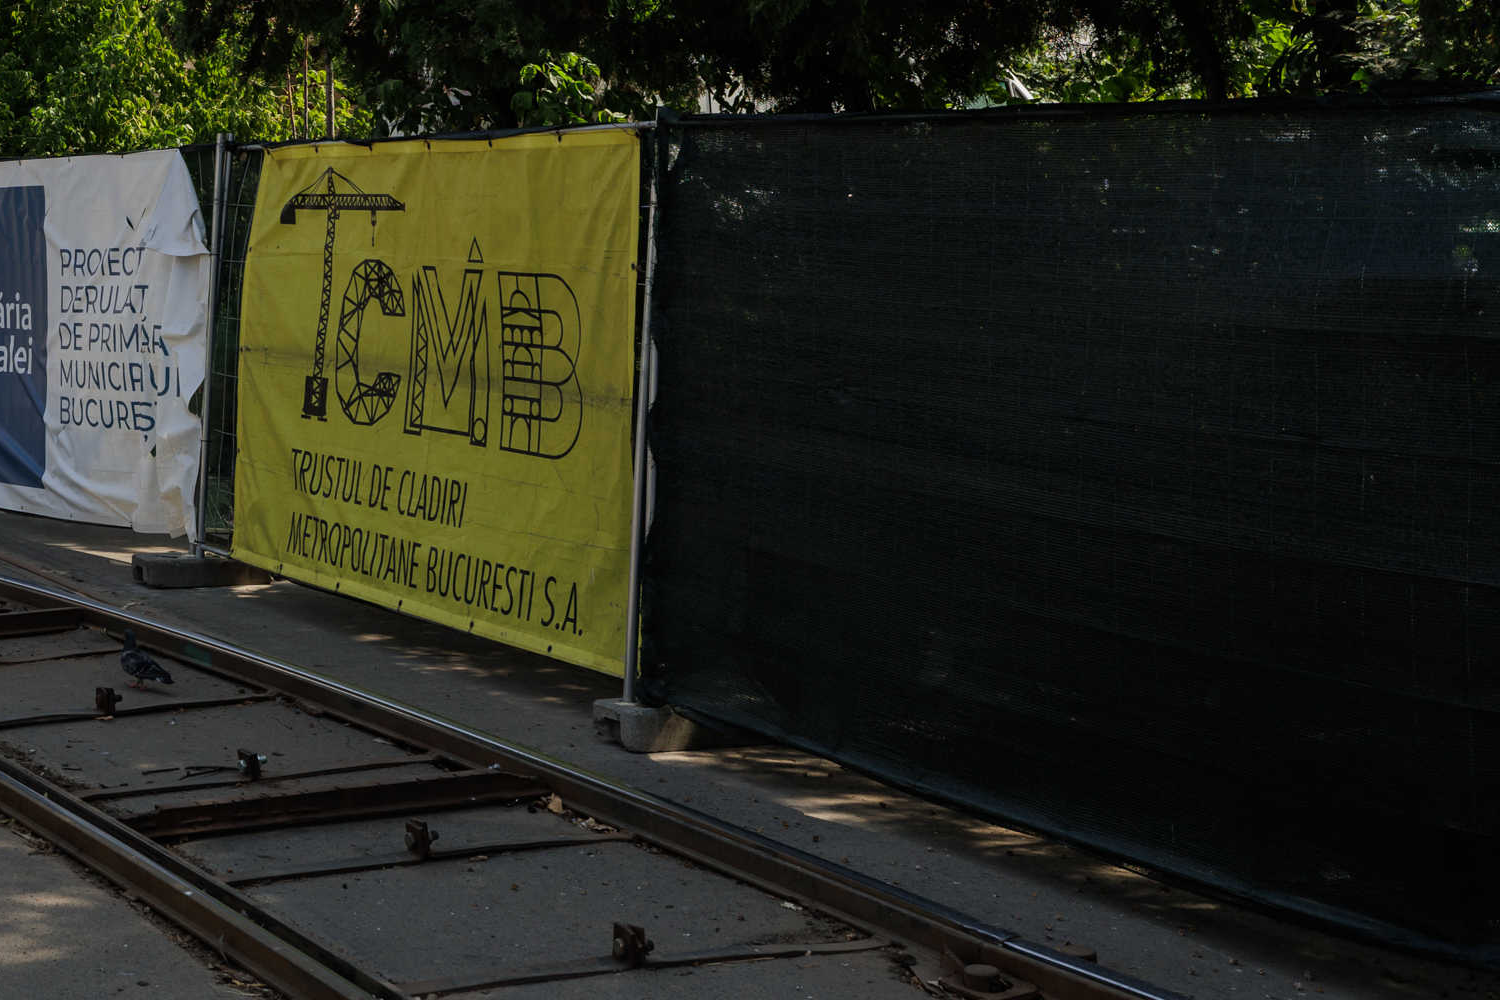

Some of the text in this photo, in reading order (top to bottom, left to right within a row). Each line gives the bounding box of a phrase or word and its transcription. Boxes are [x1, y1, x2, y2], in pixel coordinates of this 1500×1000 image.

[59, 247, 146, 277] PROIECT
[60, 285, 149, 314] DERULAT
[58, 322, 83, 351] DE
[291, 448, 468, 528] TRUSTUL DE CLADIRI
[286, 511, 584, 636] METROPOLITANE BUCURESTI S.A.
